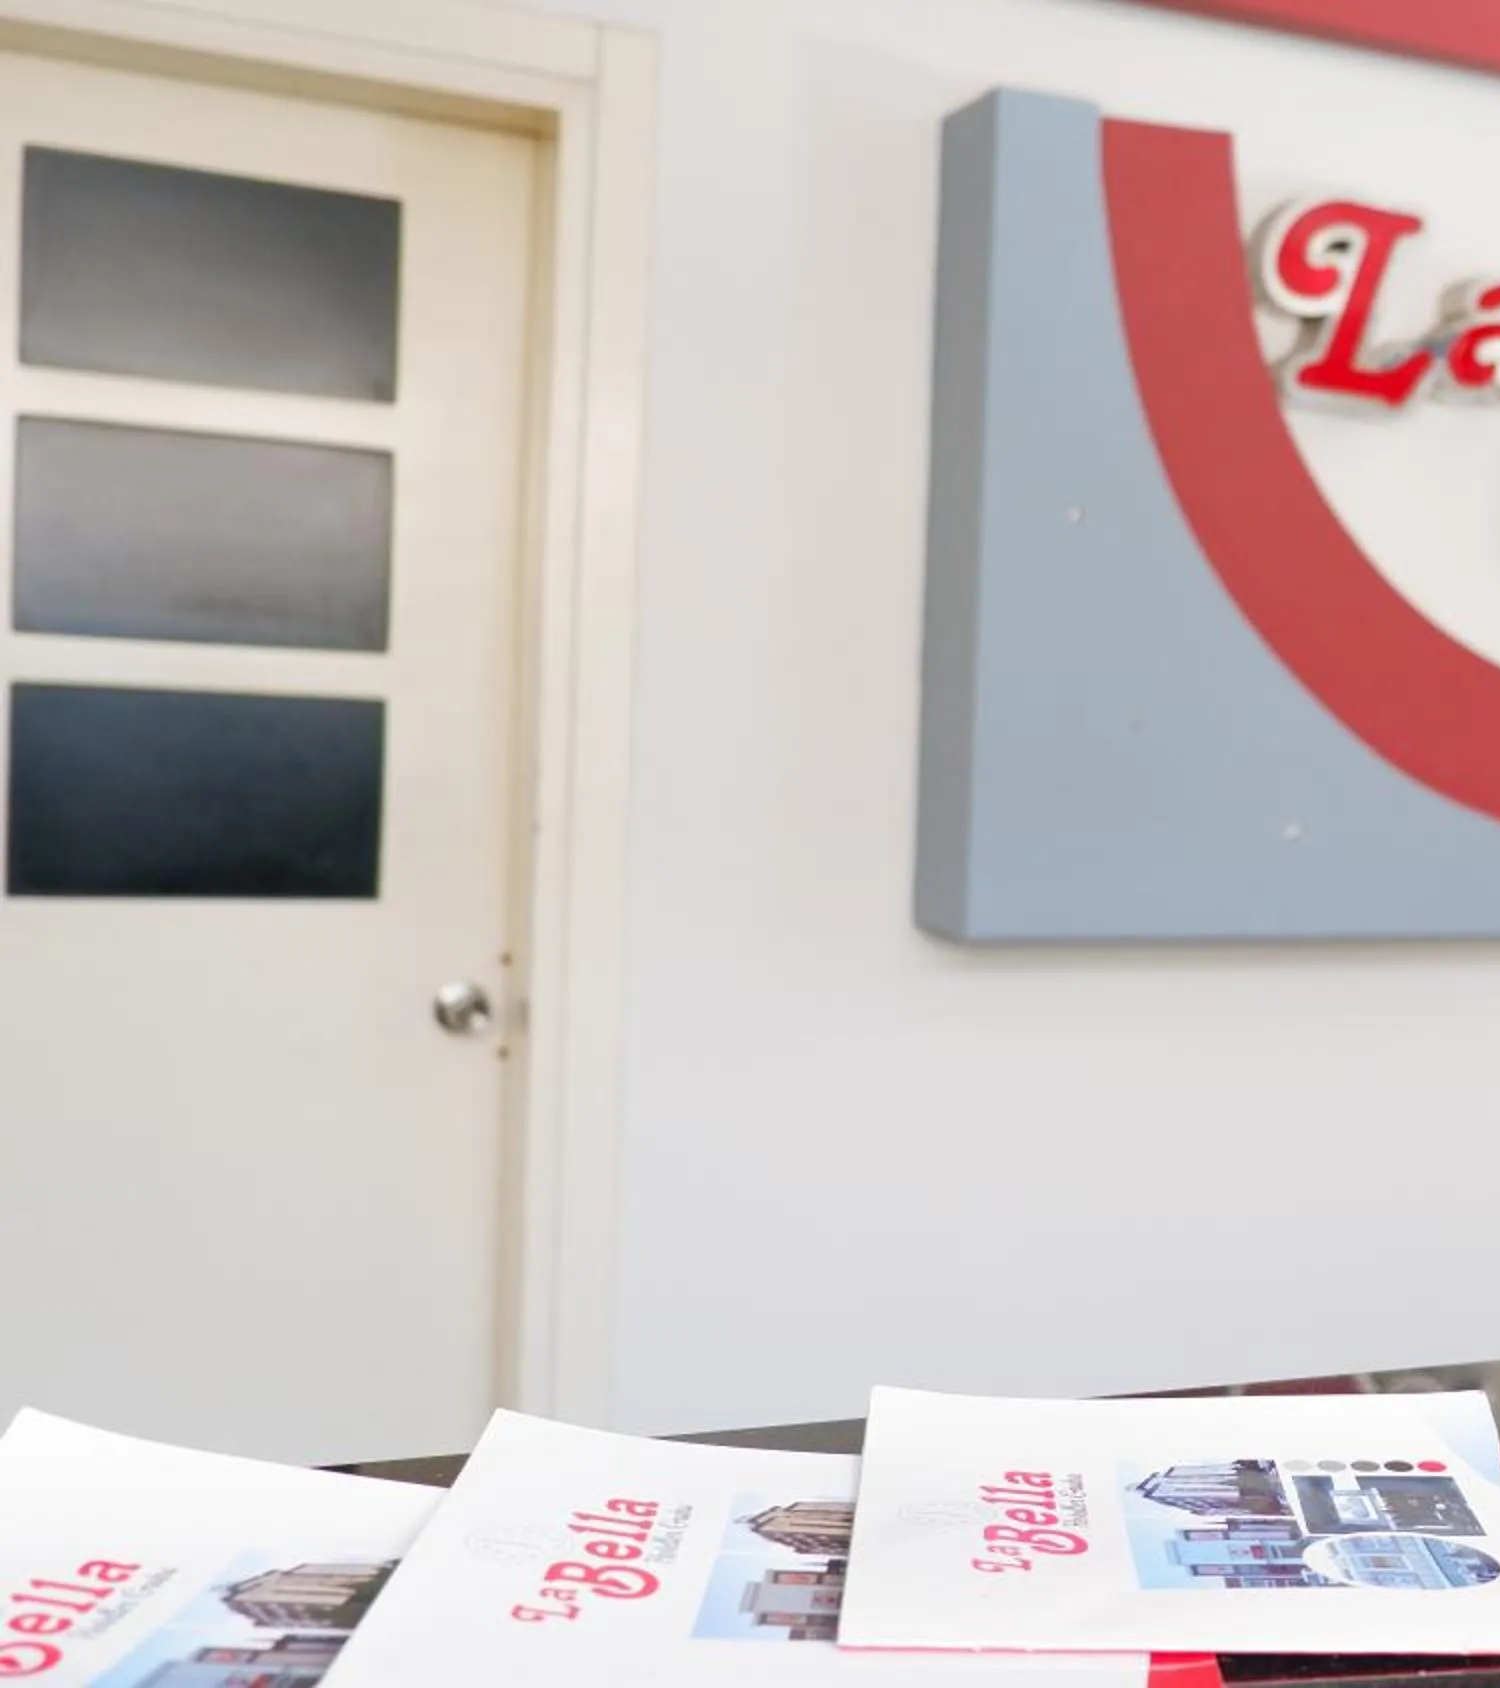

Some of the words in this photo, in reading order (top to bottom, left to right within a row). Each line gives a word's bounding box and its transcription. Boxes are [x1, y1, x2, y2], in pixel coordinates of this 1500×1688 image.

[979, 1471, 1088, 1555] Bella
[543, 1498, 660, 1600] Bella
[972, 1545, 1031, 1573] La
[510, 1585, 580, 1622] La
